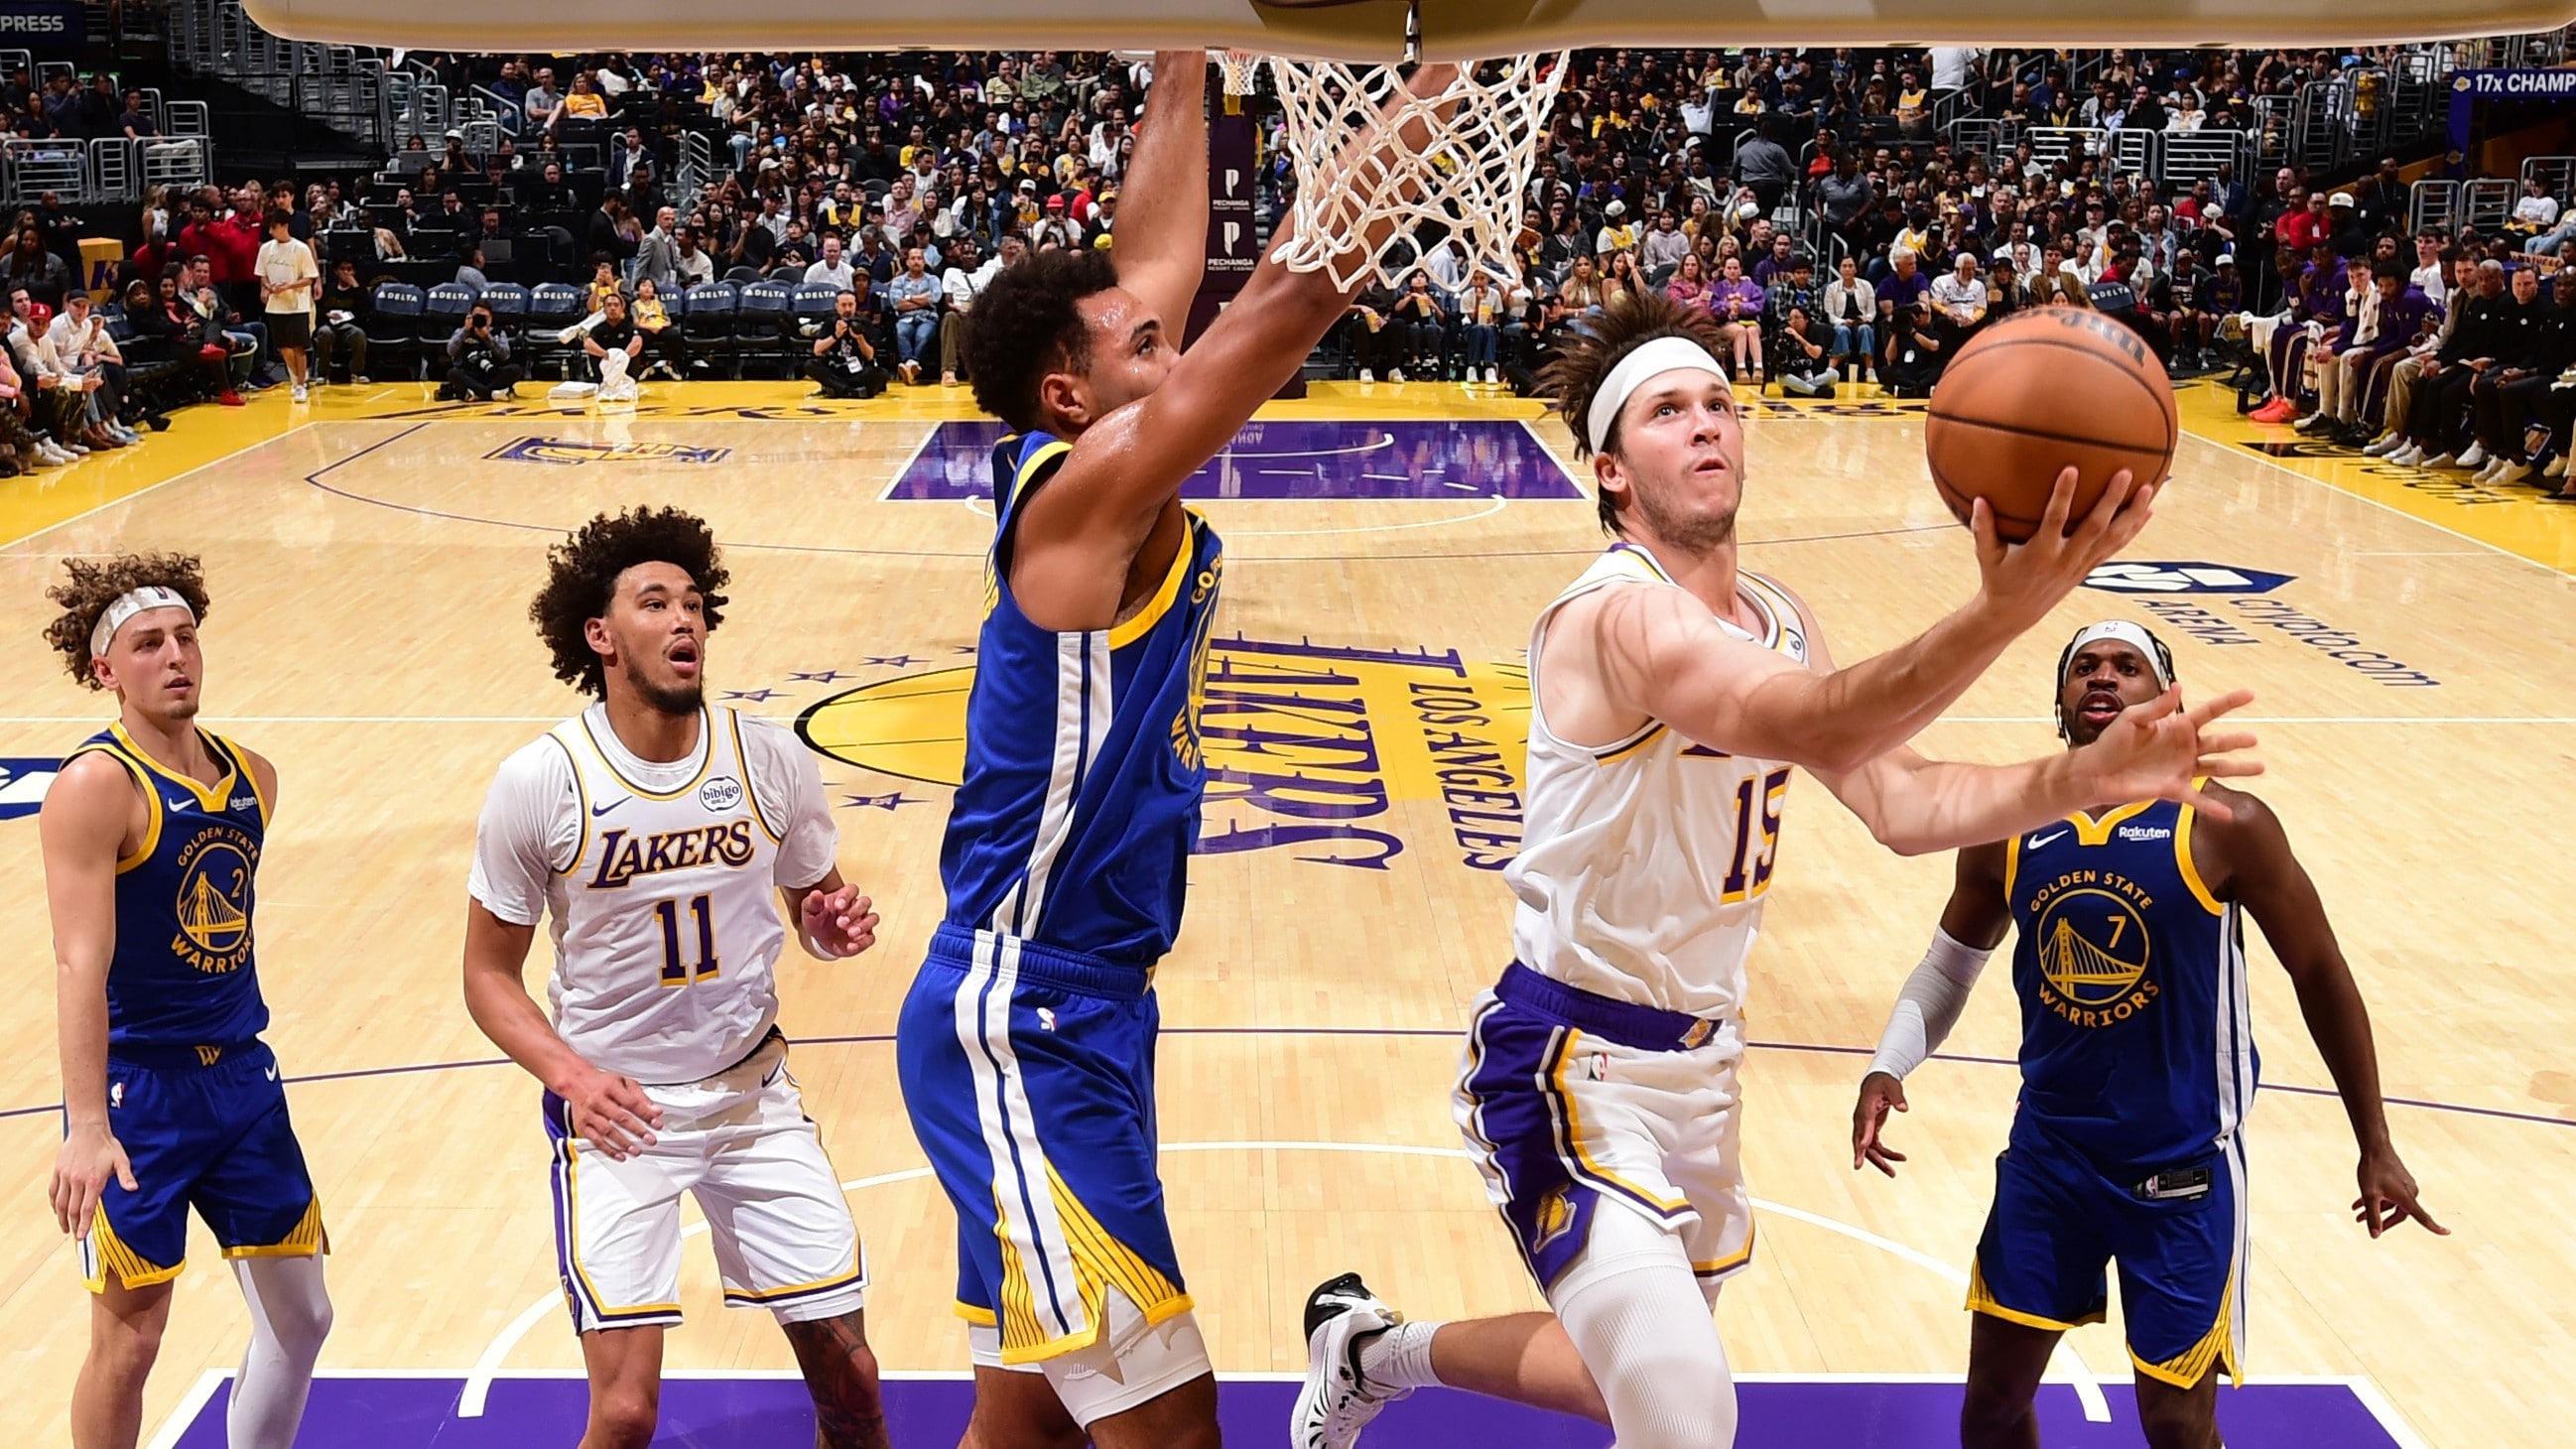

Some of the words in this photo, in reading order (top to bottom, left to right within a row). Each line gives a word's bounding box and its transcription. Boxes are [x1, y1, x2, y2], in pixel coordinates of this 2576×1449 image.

[2475, 73, 2504, 92] 17x
[2507, 72, 2576, 93] CHAMP
[387, 293, 418, 302] DELTA
[439, 292, 469, 301] DELTA
[490, 291, 521, 300] DELTA
[700, 290, 730, 300] DELTA
[754, 289, 786, 299] DELTA
[805, 290, 837, 300] DELTA
[2100, 287, 2130, 298] DELTA
[2133, 598, 2261, 645] ARENA
[2229, 597, 2441, 687] crypto.com
[1409, 682, 1491, 726] LOS
[703, 785, 739, 800] bibigo
[1424, 728, 1524, 870] ANGELES
[178, 826, 223, 866] GOLDEN
[227, 829, 258, 861] STATE
[1720, 763, 1792, 906] 15
[2119, 827, 2170, 841] Rakuten
[584, 819, 755, 889] LAKERS
[230, 868, 244, 898] 2
[2030, 869, 2097, 912] GOLDEN
[2104, 871, 2154, 910] STATE
[653, 889, 721, 988] 11
[2107, 915, 2126, 949] 7
[2039, 980, 2160, 1028] WARRIORS
